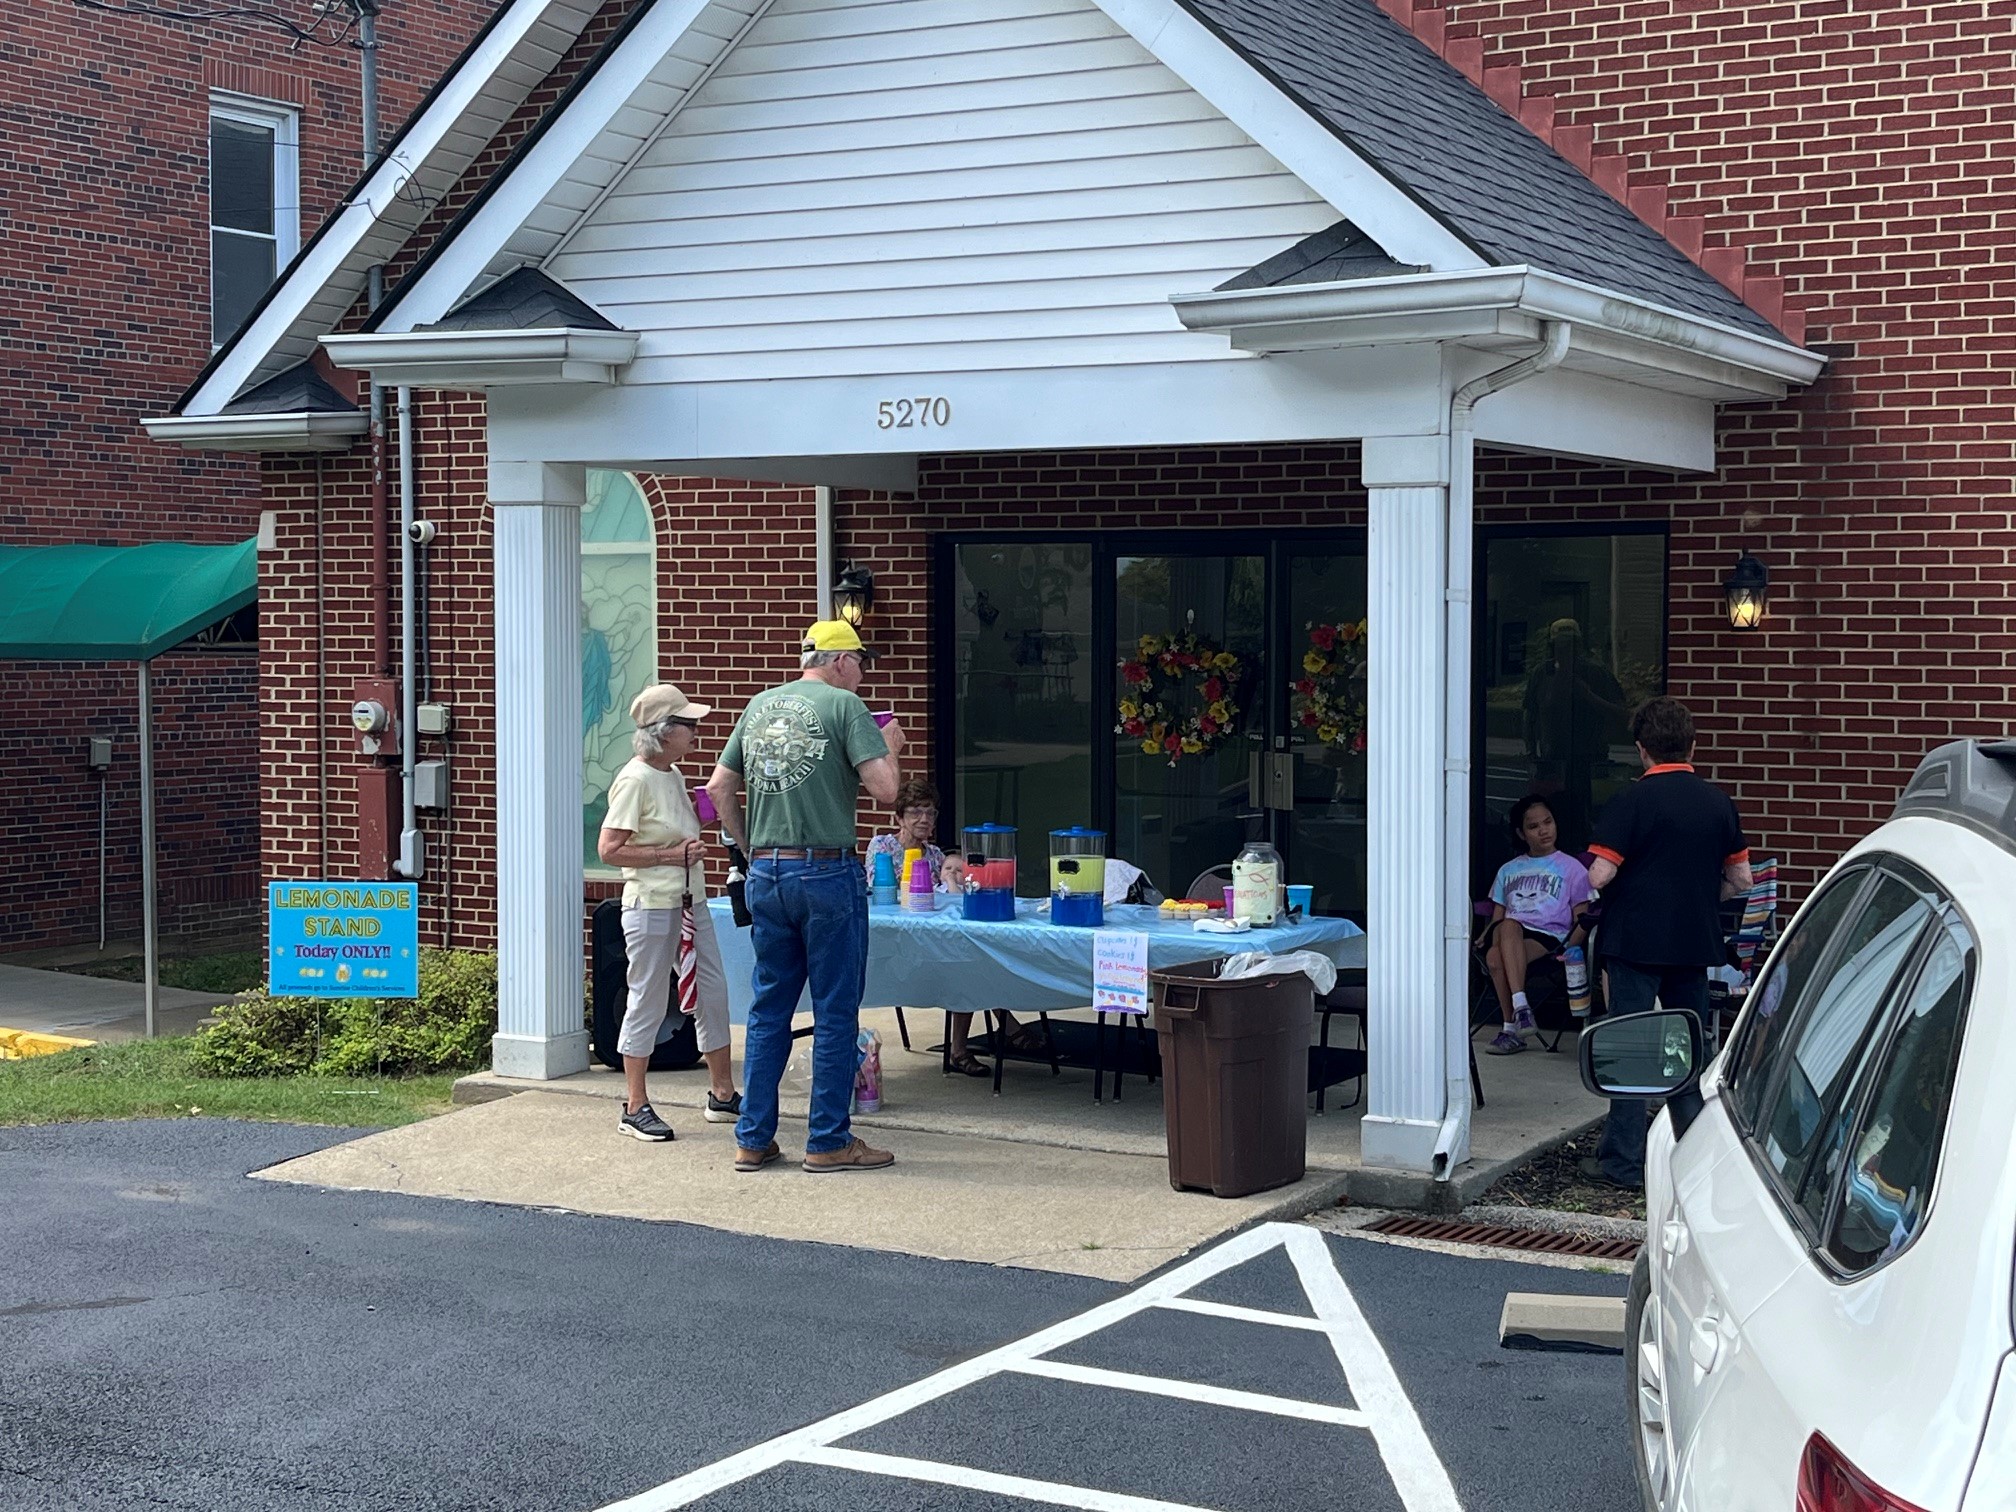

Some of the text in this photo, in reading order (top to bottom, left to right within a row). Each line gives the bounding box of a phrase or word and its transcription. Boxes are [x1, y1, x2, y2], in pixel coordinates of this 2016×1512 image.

[877, 397, 951, 430] 5270
[275, 889, 410, 909] LEMONADE
[304, 917, 381, 937] STAND
[294, 944, 391, 961] Today ONLY!!
